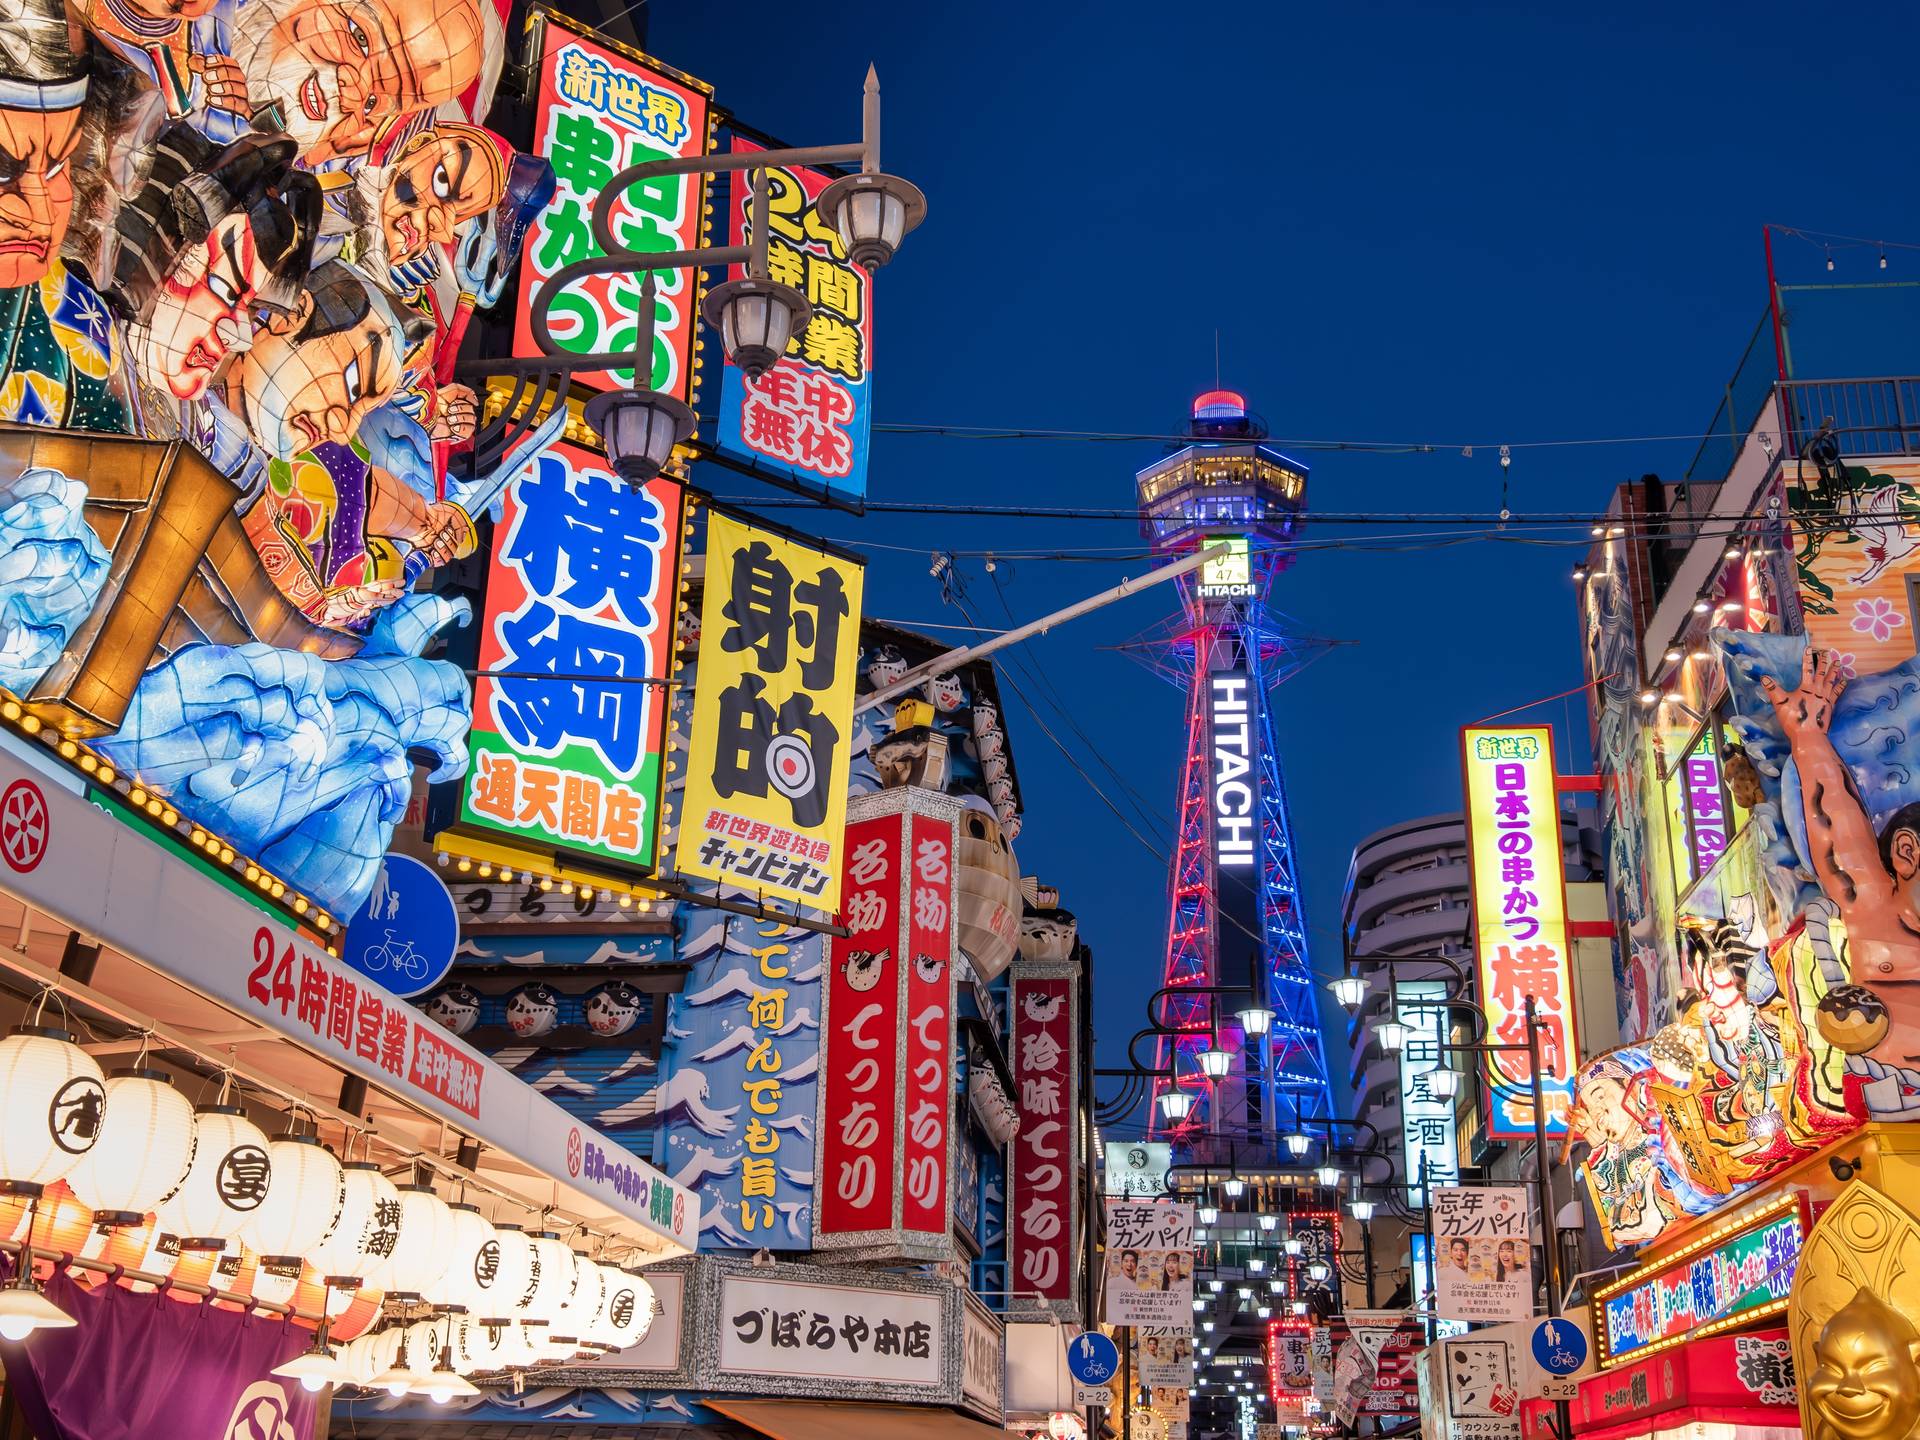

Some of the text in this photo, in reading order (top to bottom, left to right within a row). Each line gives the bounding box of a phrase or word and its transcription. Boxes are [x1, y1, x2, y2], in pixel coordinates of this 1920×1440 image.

[560, 49, 688, 144] 新世界
[539, 113, 614, 355] 串かつ
[609, 141, 680, 391] 日本一の
[752, 369, 848, 425] 年中
[750, 401, 845, 469] 無休
[1198, 584, 1257, 597] HITACHI
[1216, 569, 1233, 581] 47
[498, 458, 660, 775] 横綱
[711, 540, 851, 828] 射的
[1212, 678, 1254, 865] HITACHI
[1477, 736, 1539, 760] 新世界
[475, 752, 643, 852] 通天閣店
[699, 837, 831, 895] チャンピオン
[703, 810, 831, 863] 新世界遊技場
[1494, 763, 1540, 941] 日本一の串かつ
[848, 838, 888, 934] 名物
[913, 838, 948, 934] 名物
[247, 926, 408, 1078] 24時間営業
[1491, 944, 1567, 1082] 横綱
[414, 1032, 479, 1112] 年中無休
[583, 1142, 674, 1230] 日本一の串かつ 横綱
[1108, 1206, 1156, 1229] 忘年
[1434, 1191, 1485, 1215] 忘年
[365, 1197, 402, 1260] 横綱
[732, 1306, 931, 1360] づぼらや本店
[1287, 1339, 1305, 1376] 串カツ
[1078, 1391, 1109, 1402] 9-22
[1542, 1384, 1577, 1396] 9-22
[1464, 1422, 1520, 1433] カウンター席
